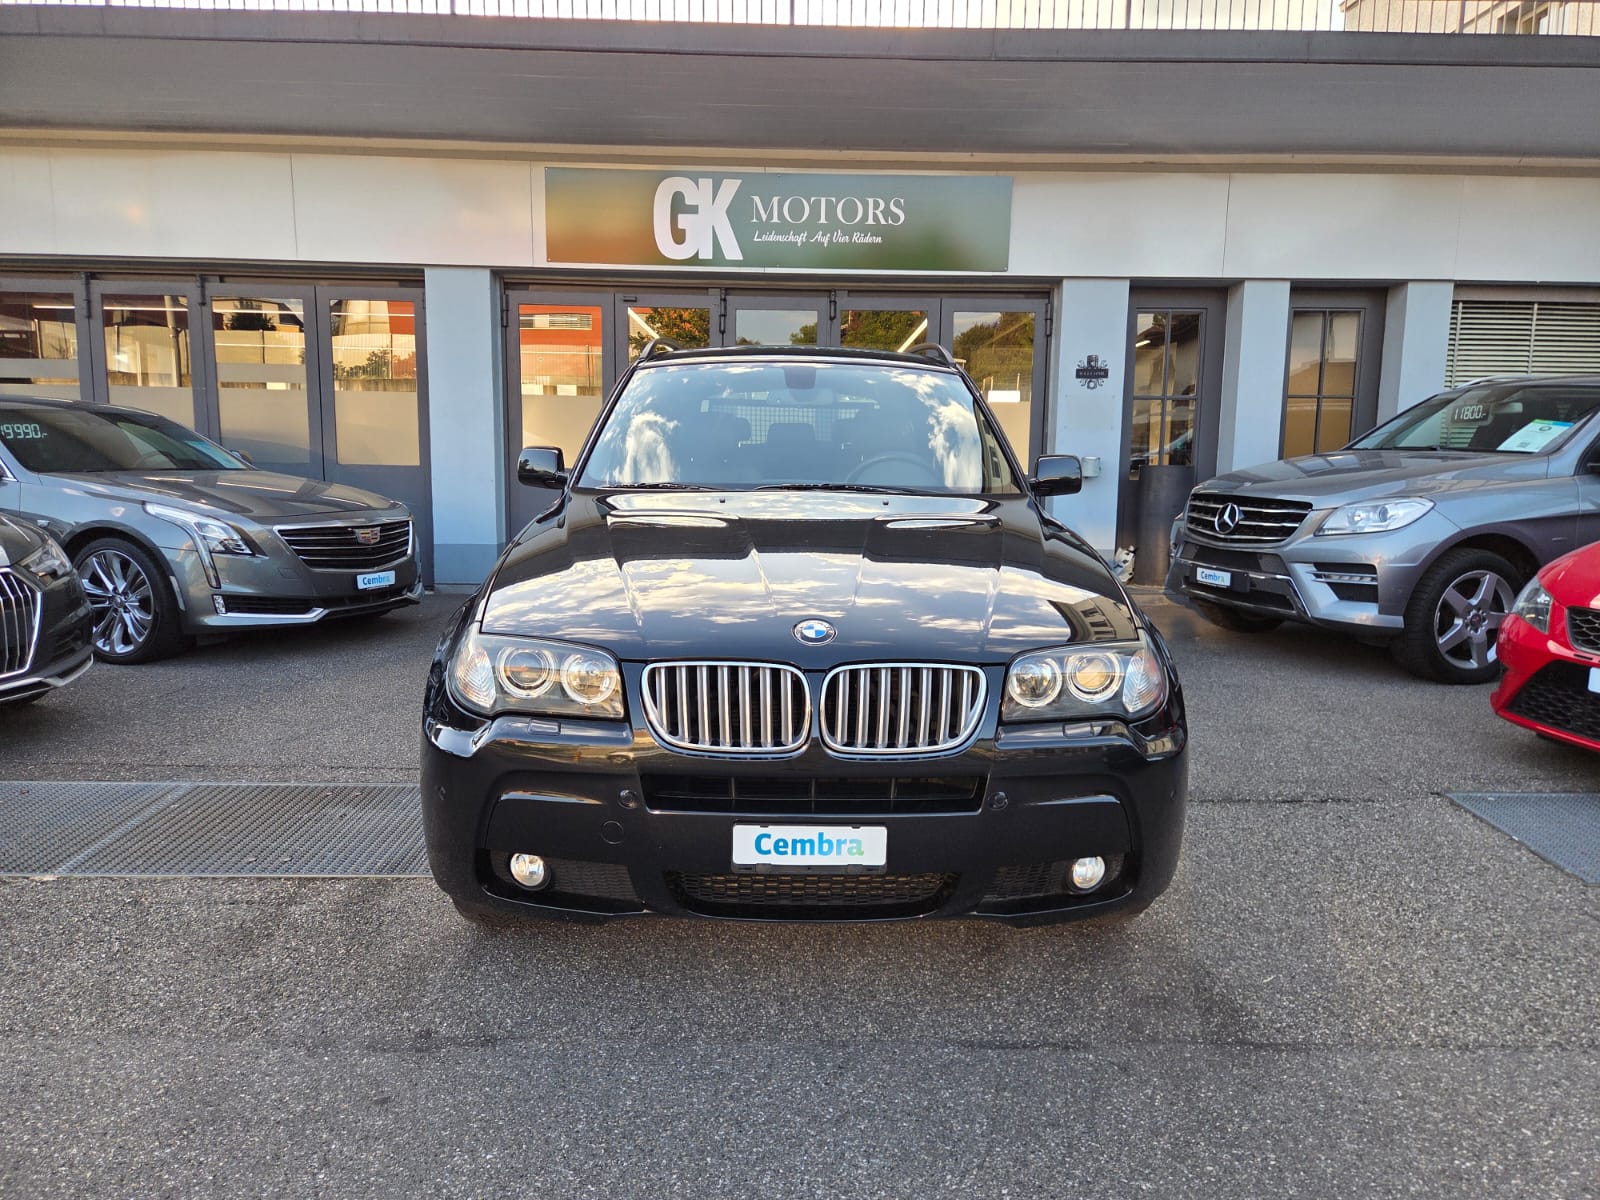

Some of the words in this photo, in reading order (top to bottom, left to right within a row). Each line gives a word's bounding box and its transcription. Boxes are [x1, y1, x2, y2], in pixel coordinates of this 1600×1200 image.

[653, 176, 744, 260] GK
[751, 195, 906, 226] MOTORS
[753, 229, 808, 247] Leidenschaft
[810, 230, 831, 248] Auf
[832, 229, 850, 243] Vier
[851, 231, 883, 244] Rädern
[1200, 570, 1225, 584] Cembra
[754, 832, 865, 857] Cembra
